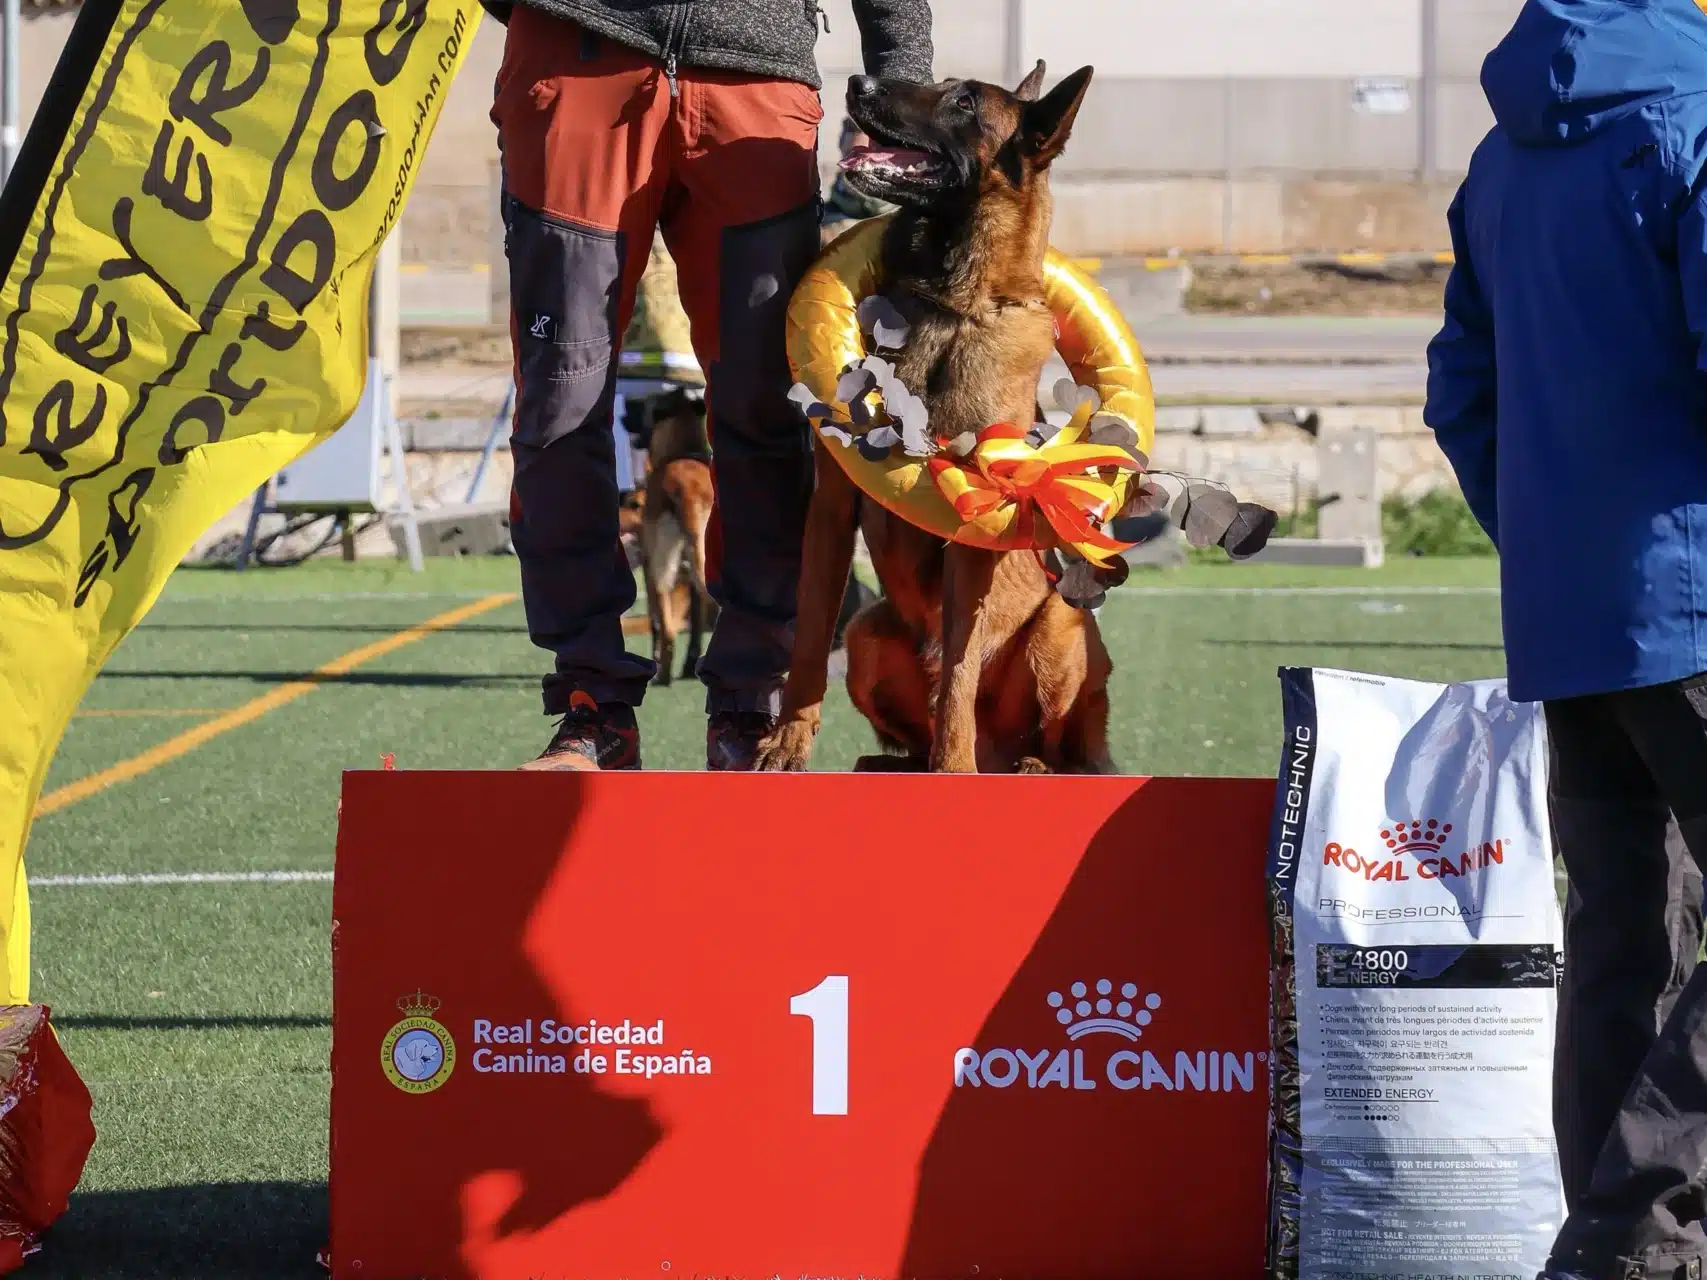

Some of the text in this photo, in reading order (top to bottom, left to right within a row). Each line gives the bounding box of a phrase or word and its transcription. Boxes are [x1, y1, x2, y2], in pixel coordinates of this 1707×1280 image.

[1323, 838, 1504, 882] ROYAL CANIN
[1319, 898, 1482, 920] PROFESSIONAL
[1351, 950, 1408, 971] 4800
[1344, 1004, 1360, 1013] with
[1379, 1005, 1397, 1014] long
[1398, 1005, 1427, 1014] periods
[1437, 1005, 1474, 1013] sustained
[1476, 1005, 1503, 1014] activity
[1352, 1017, 1373, 1025] ayant
[1374, 1016, 1384, 1024] de
[1386, 1016, 1401, 1024] très
[1403, 1016, 1435, 1026] longues
[383, 1019, 452, 1063] REAL SOCIEDAD CANINA
[474, 1019, 664, 1045] Real Sociedad
[1402, 1029, 1421, 1037] muy
[1422, 1028, 1447, 1038] largos
[1449, 1028, 1459, 1036] de
[1461, 1028, 1497, 1036] actividad
[1498, 1028, 1535, 1036] sostenida
[790, 975, 849, 1116] 1
[472, 1048, 712, 1078] Canina de España
[953, 1047, 1254, 1093] ROYAL CANIN
[1324, 1087, 1434, 1099] EXTENDED ENERGY
[1397, 1161, 1414, 1169] FOR
[1415, 1161, 1432, 1169] THE
[1434, 1161, 1496, 1169] PROFESSIONAL
[1338, 1229, 1353, 1238] FOR
[1383, 1231, 1403, 1240] SALE
